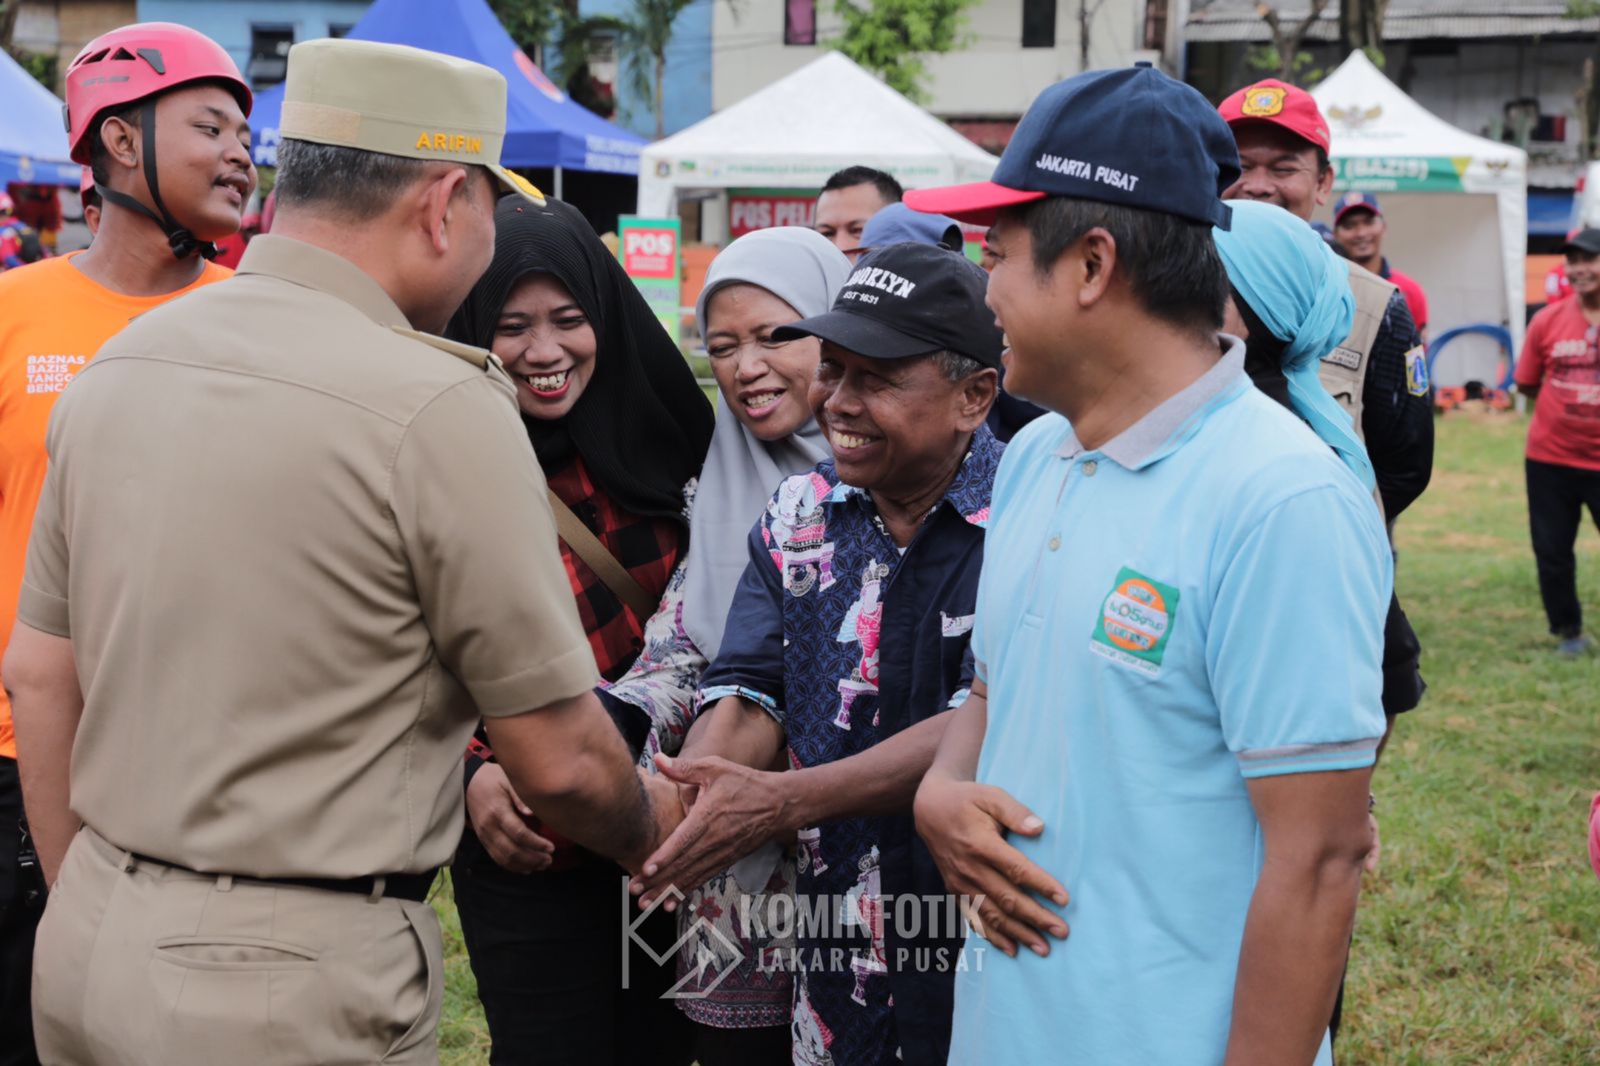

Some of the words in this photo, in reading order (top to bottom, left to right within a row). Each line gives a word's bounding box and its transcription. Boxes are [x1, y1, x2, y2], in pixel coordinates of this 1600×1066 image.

[416, 132, 484, 153] ARIFIN
[1036, 153, 1091, 179] JAKARTA
[1095, 166, 1139, 191] PUSAT
[732, 202, 771, 228] POS
[626, 233, 673, 256] POS
[27, 355, 86, 364] BAZNAS
[27, 364, 68, 374] BAZIS
